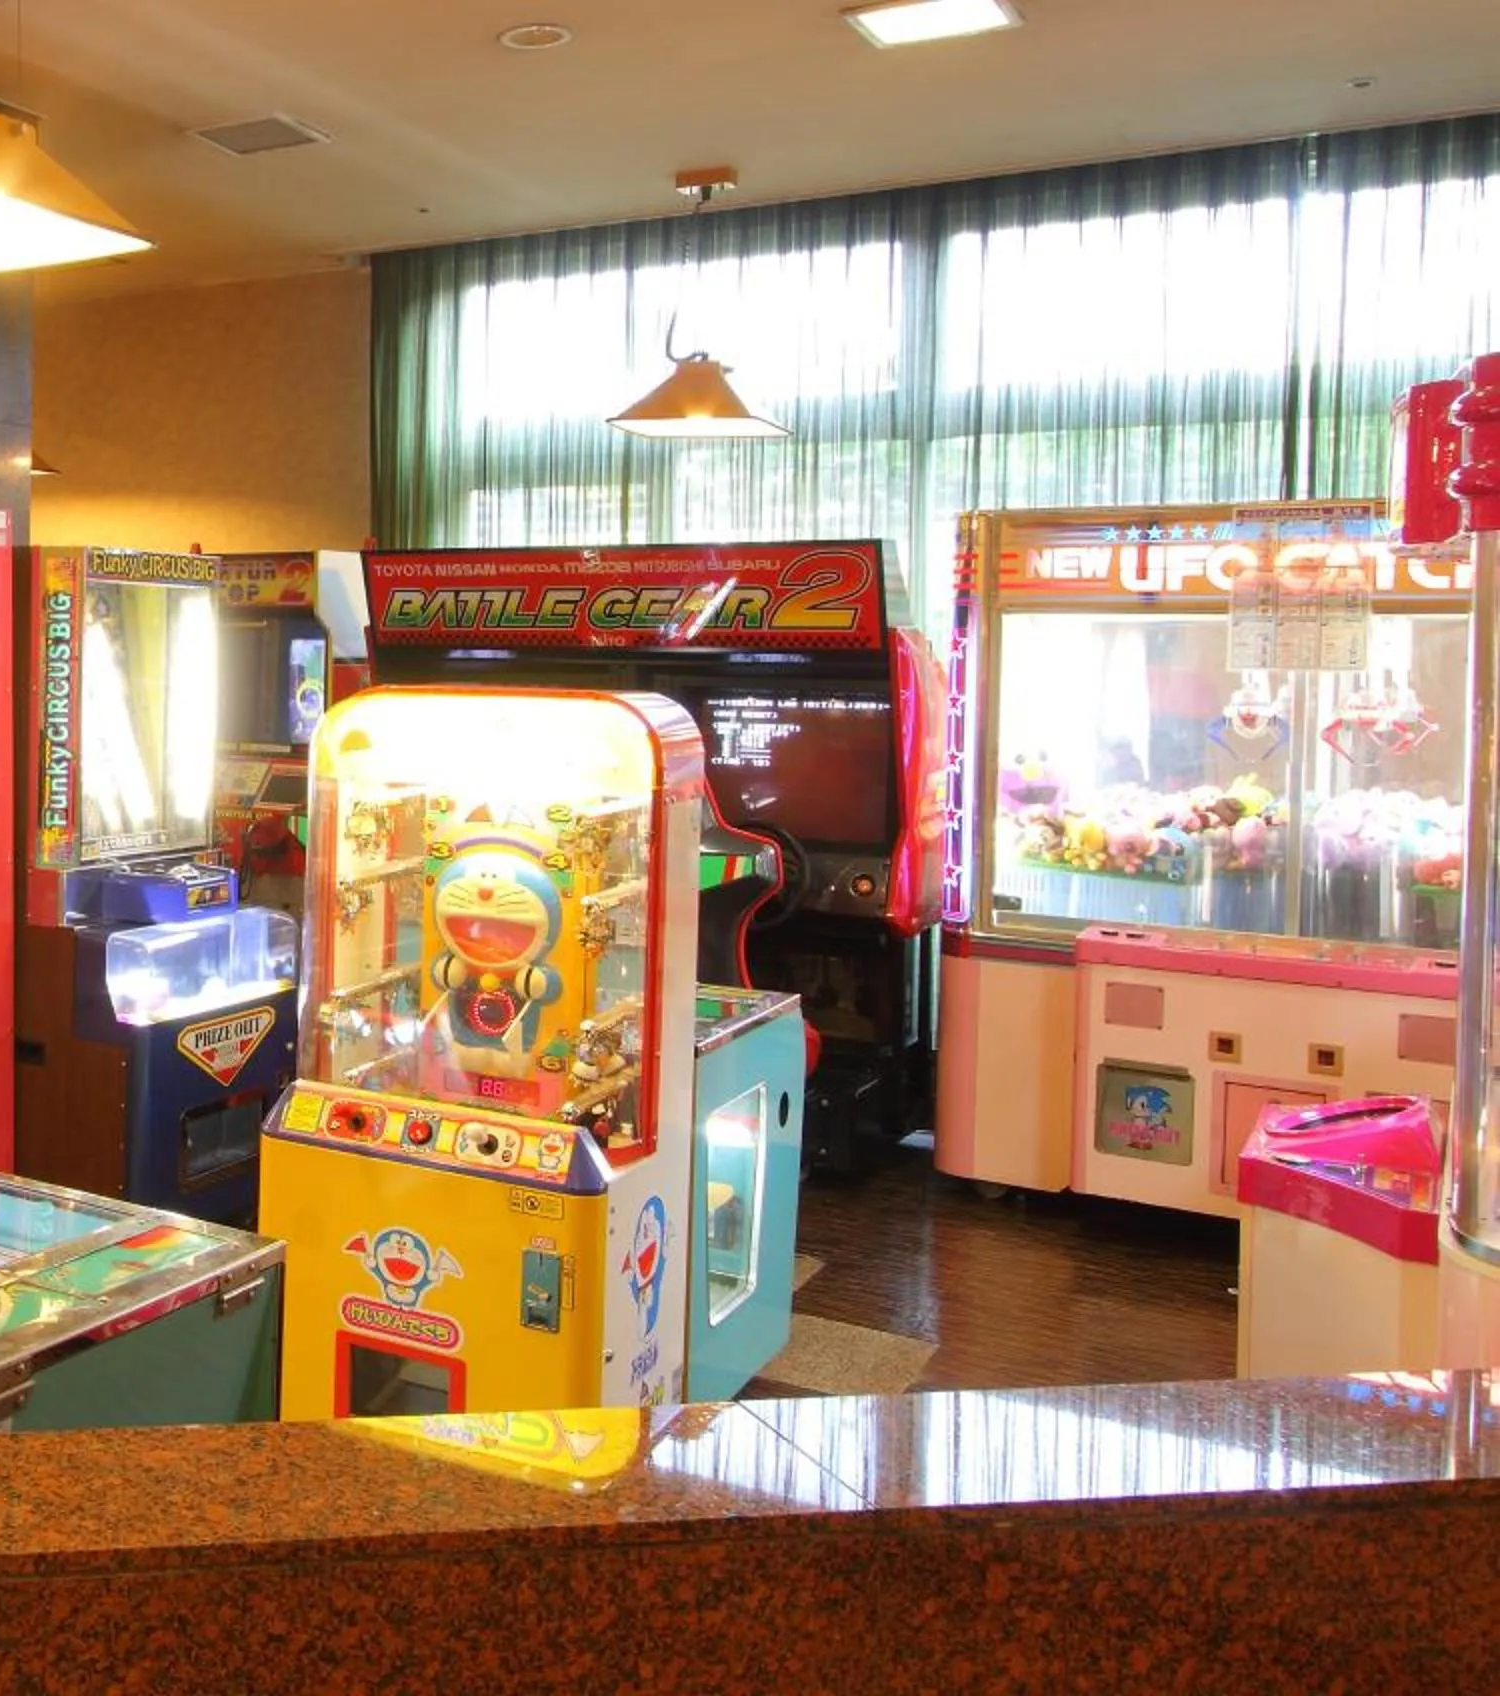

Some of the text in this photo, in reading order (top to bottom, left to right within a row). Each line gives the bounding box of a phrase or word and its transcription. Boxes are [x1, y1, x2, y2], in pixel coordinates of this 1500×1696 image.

[93, 551, 217, 580] Funky CIRCUS BIG
[373, 564, 433, 577] TOYOTA
[434, 562, 498, 577] NISSAN
[499, 565, 562, 574] HONDA
[706, 559, 781, 571] SUBARU
[1026, 546, 1113, 580] NEW
[1119, 542, 1259, 593] UFO
[382, 549, 874, 632] BATTLE GEAR 2
[45, 592, 73, 829] Funky CIRCUS BIG
[194, 1015, 263, 1049] PRIZE OUT
